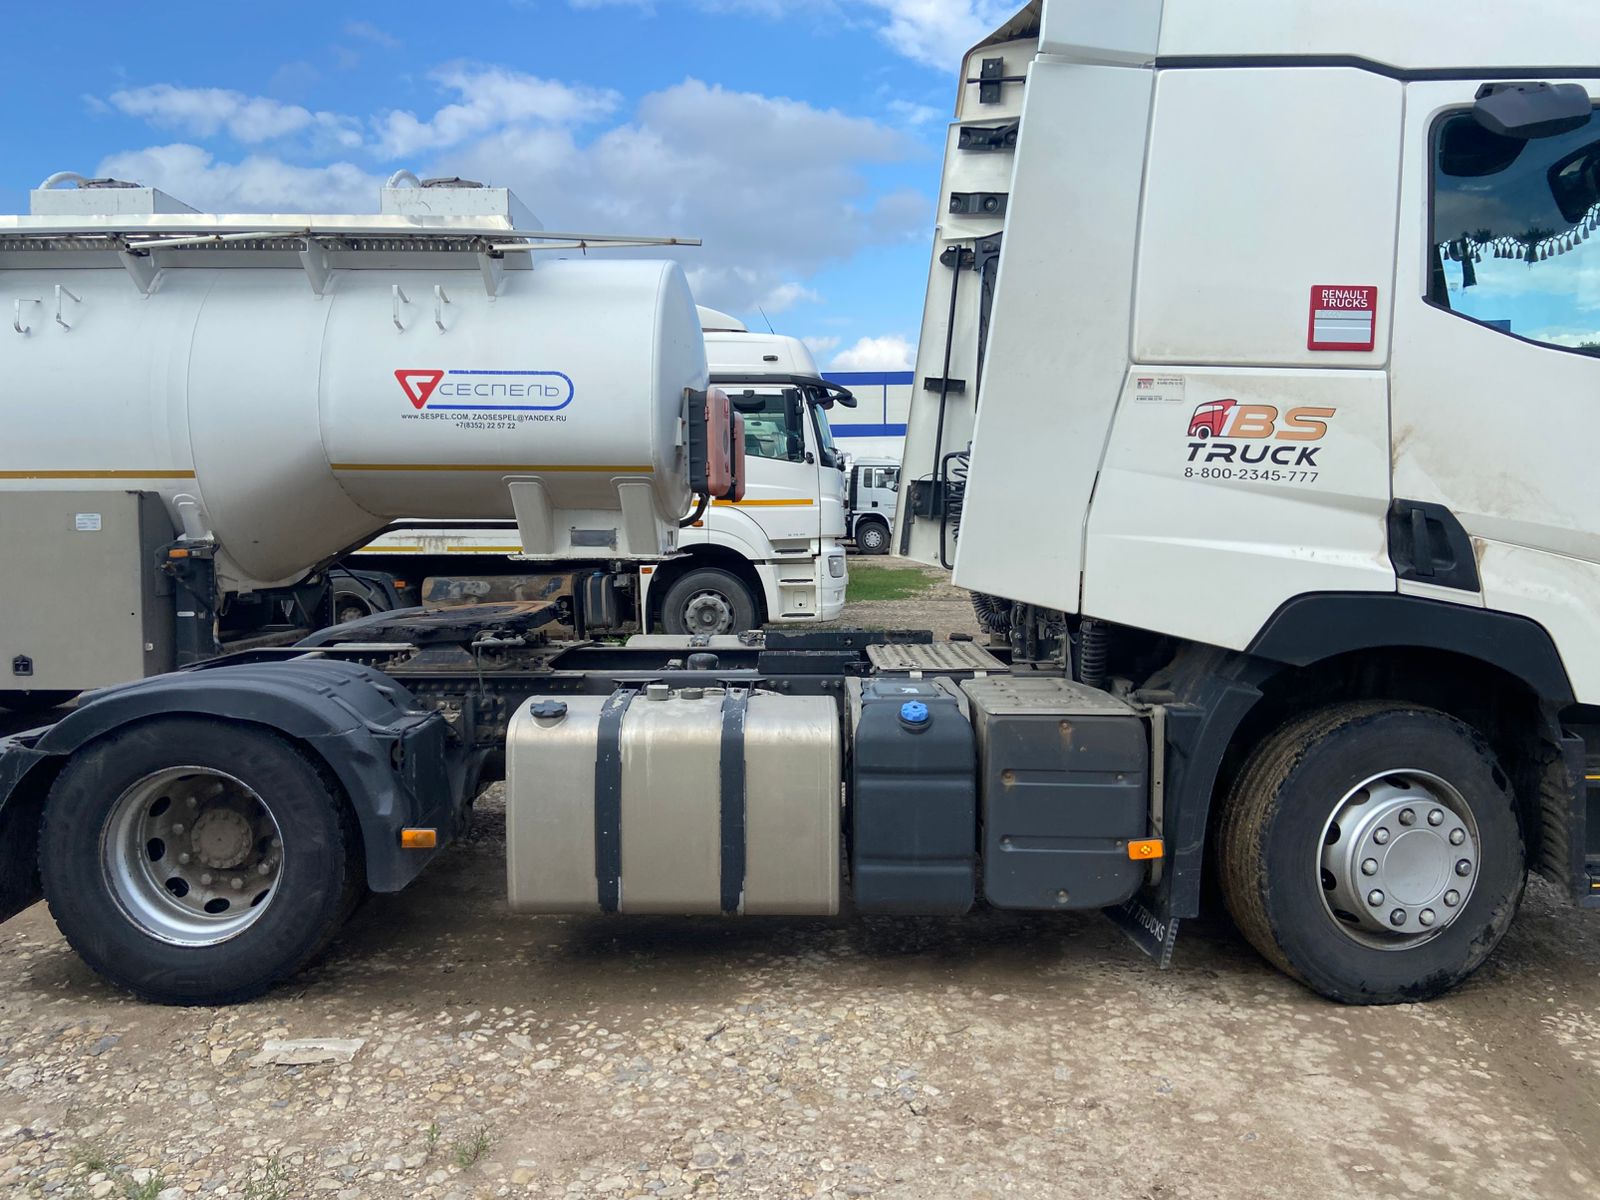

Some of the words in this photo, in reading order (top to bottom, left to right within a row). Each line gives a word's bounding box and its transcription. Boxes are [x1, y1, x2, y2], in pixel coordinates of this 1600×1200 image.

[1322, 289, 1369, 299] RENAULT
[1322, 298, 1368, 308] TRUCKS
[439, 383, 560, 397] СЕСПЕЛЬ
[472, 414, 567, 422] ZAOSESPEL@YANDEX.RU
[455, 422, 485, 430] +7(8352)
[507, 422, 516, 430] 22
[1187, 442, 1322, 467] TRUCK
[1184, 467, 1319, 483] 8-800-2345-777
[1134, 904, 1166, 942] TRUCKS
